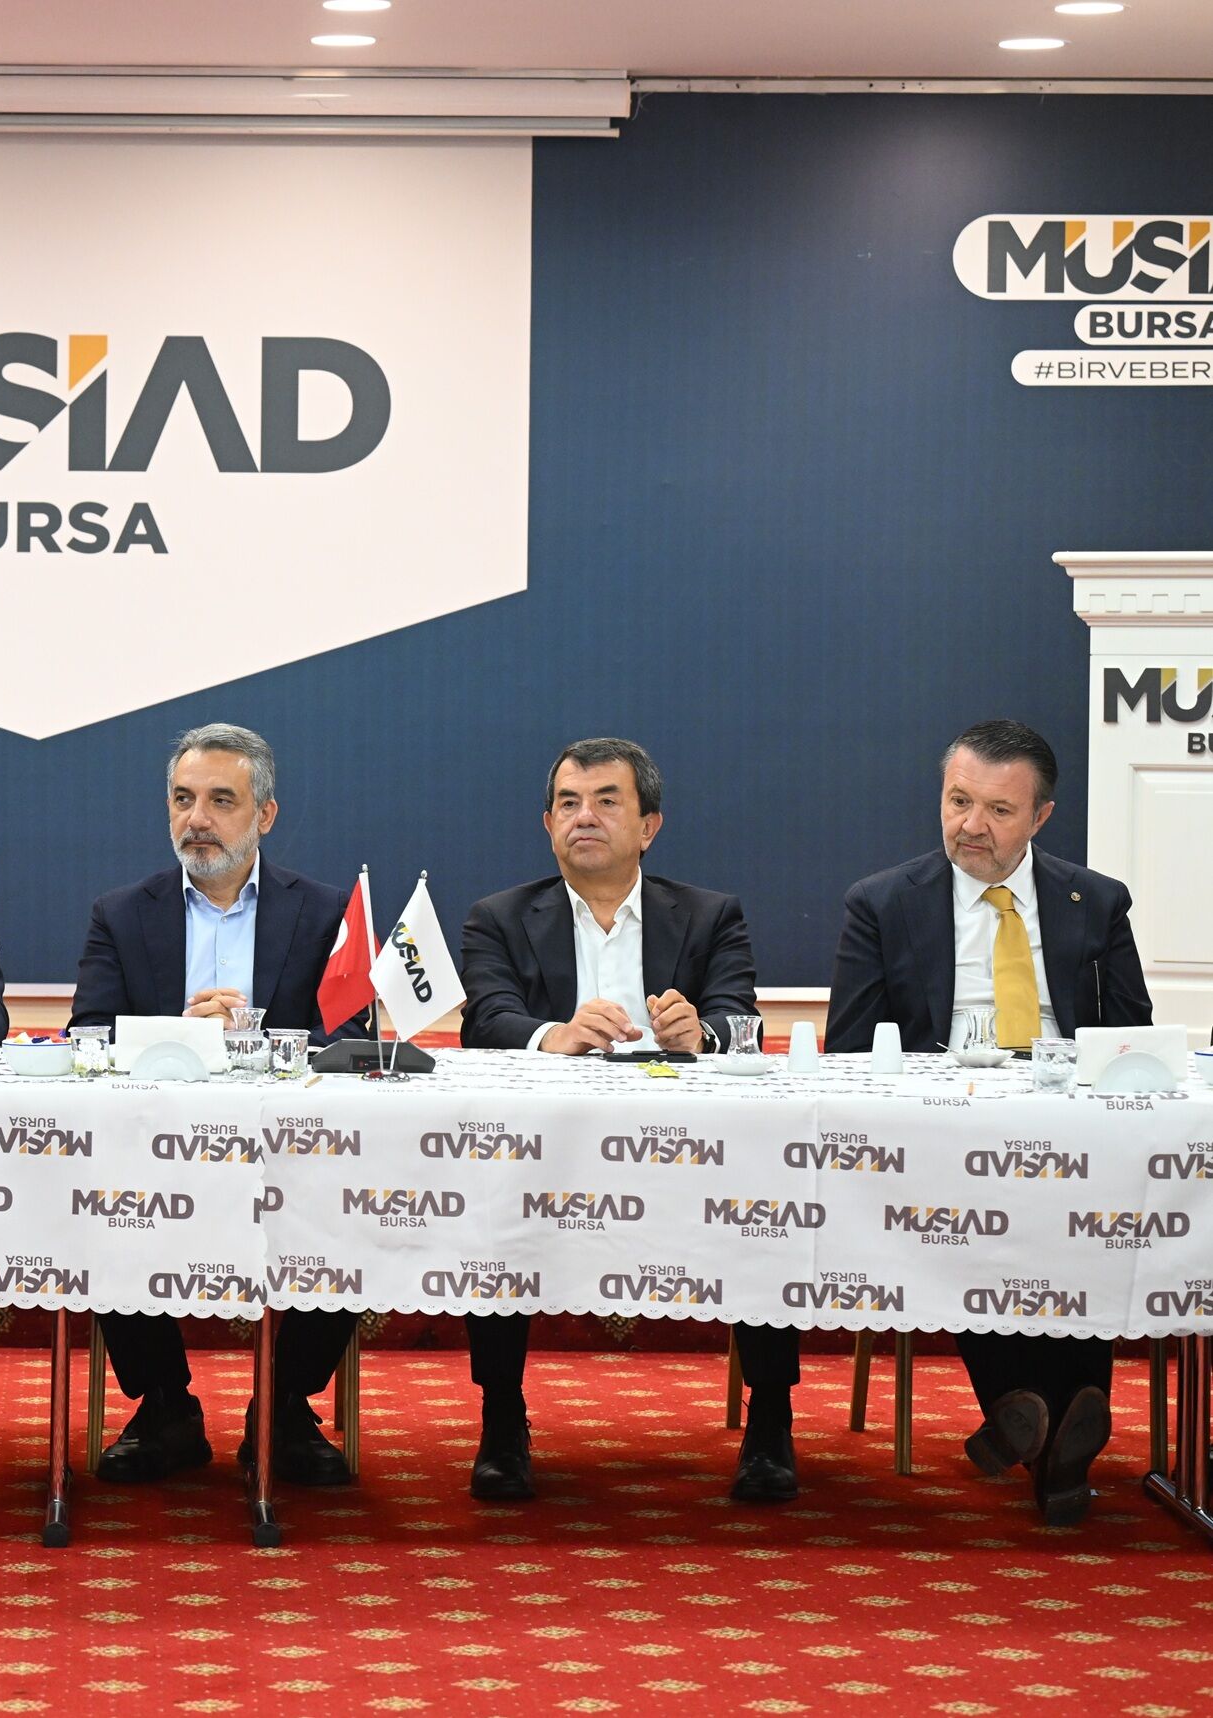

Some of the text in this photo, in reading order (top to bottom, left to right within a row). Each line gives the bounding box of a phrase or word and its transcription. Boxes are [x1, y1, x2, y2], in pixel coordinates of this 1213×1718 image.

[1106, 1101, 1153, 1110] BURSA
[9, 1116, 55, 1128] BURSA
[277, 1117, 323, 1127] BURSA
[458, 1122, 504, 1132] BURSA
[191, 1124, 237, 1135] BURSA
[640, 1126, 687, 1137] BURSA
[821, 1132, 867, 1144] BURSA
[1004, 1140, 1051, 1151] BURSA
[109, 1218, 155, 1229] BURSA
[380, 1217, 427, 1227] BURSA
[558, 1219, 605, 1230] BURSA
[741, 1227, 788, 1238] BURSA
[921, 1234, 969, 1245] BURSA
[1106, 1239, 1151, 1249] BURSA
[6, 1256, 52, 1267] BURSA
[278, 1255, 325, 1266] BURSA
[460, 1261, 505, 1271] BURSA
[188, 1263, 234, 1274] BURSA
[638, 1265, 685, 1276] BURSA
[820, 1272, 866, 1283] BURSA
[1002, 1279, 1049, 1289] BURSA
